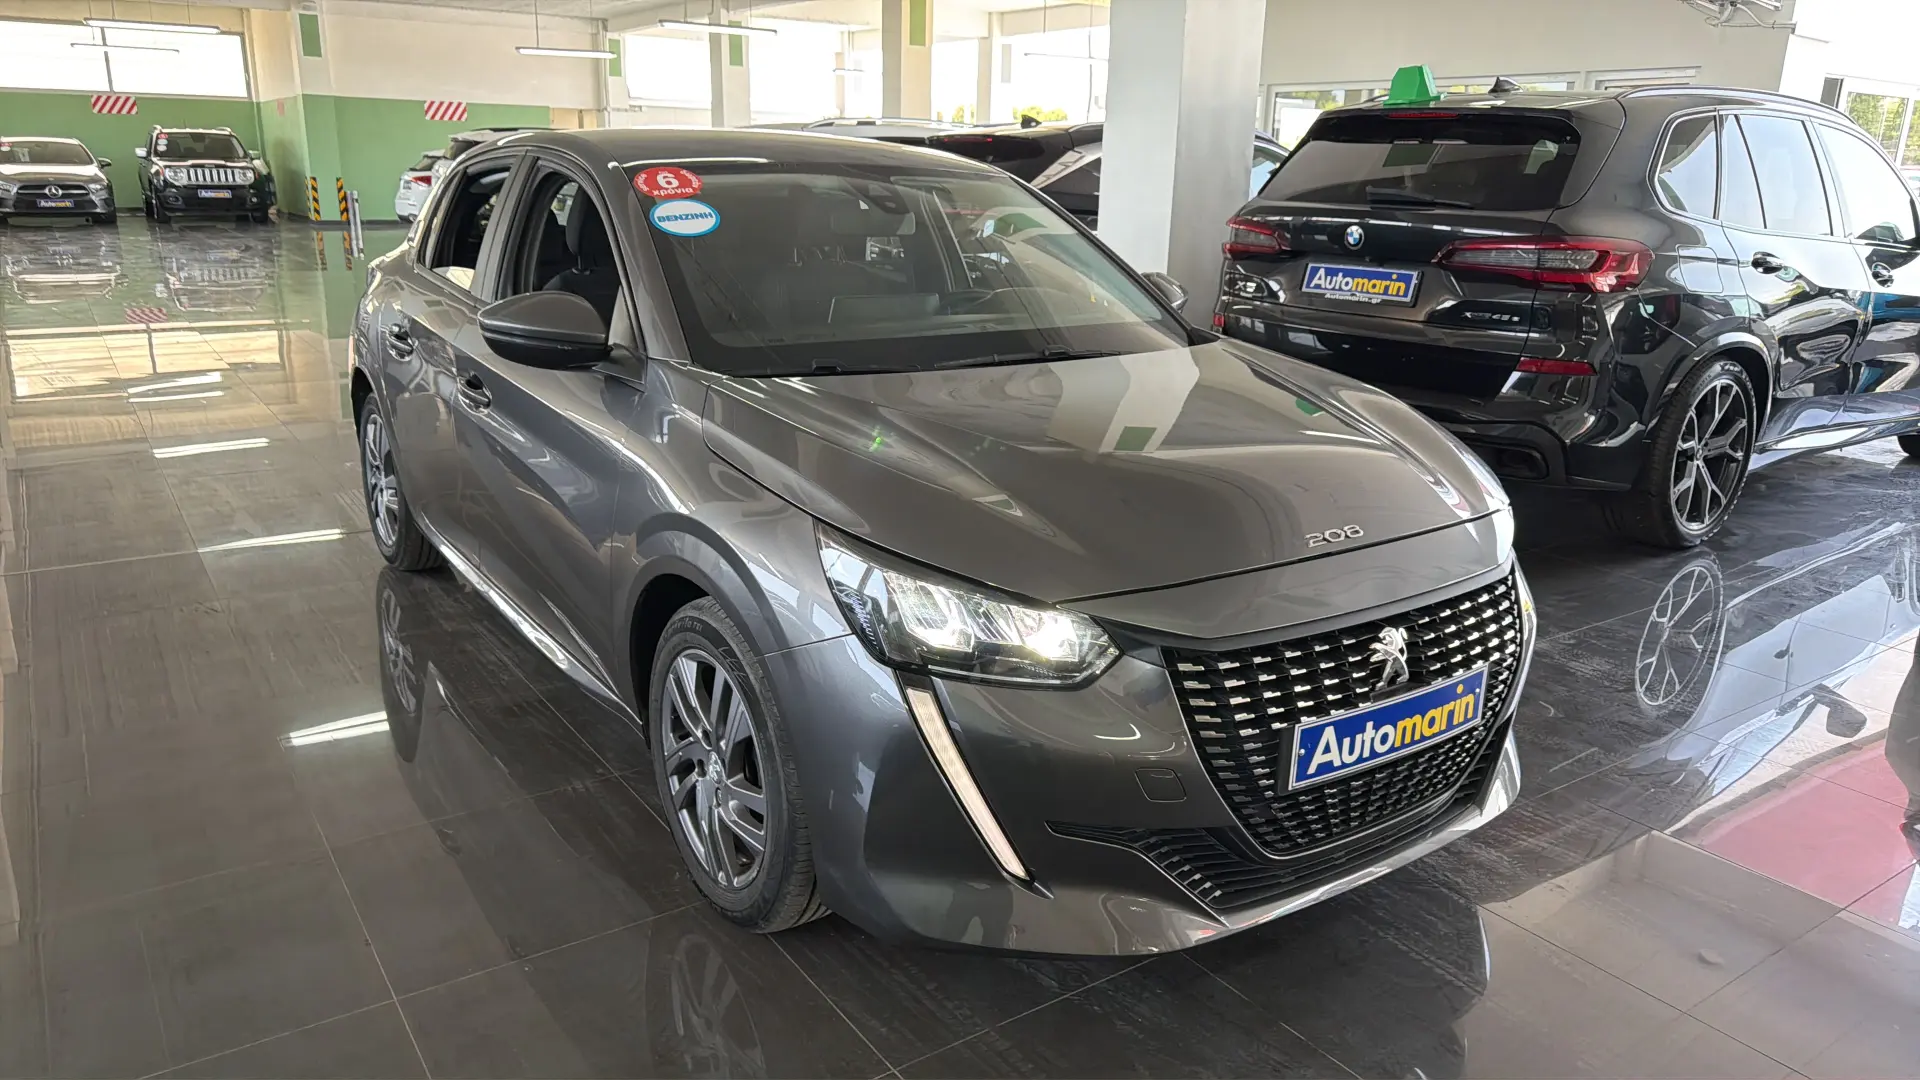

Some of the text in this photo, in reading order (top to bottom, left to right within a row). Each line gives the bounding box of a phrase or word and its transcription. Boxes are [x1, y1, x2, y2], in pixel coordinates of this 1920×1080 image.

[656, 173, 679, 188] 6
[652, 187, 694, 196] χρόνια
[1309, 267, 1407, 296] Automarin
[1324, 293, 1382, 304] Automarin.gr
[1304, 524, 1364, 548] 208
[1306, 684, 1476, 775] Automarin
